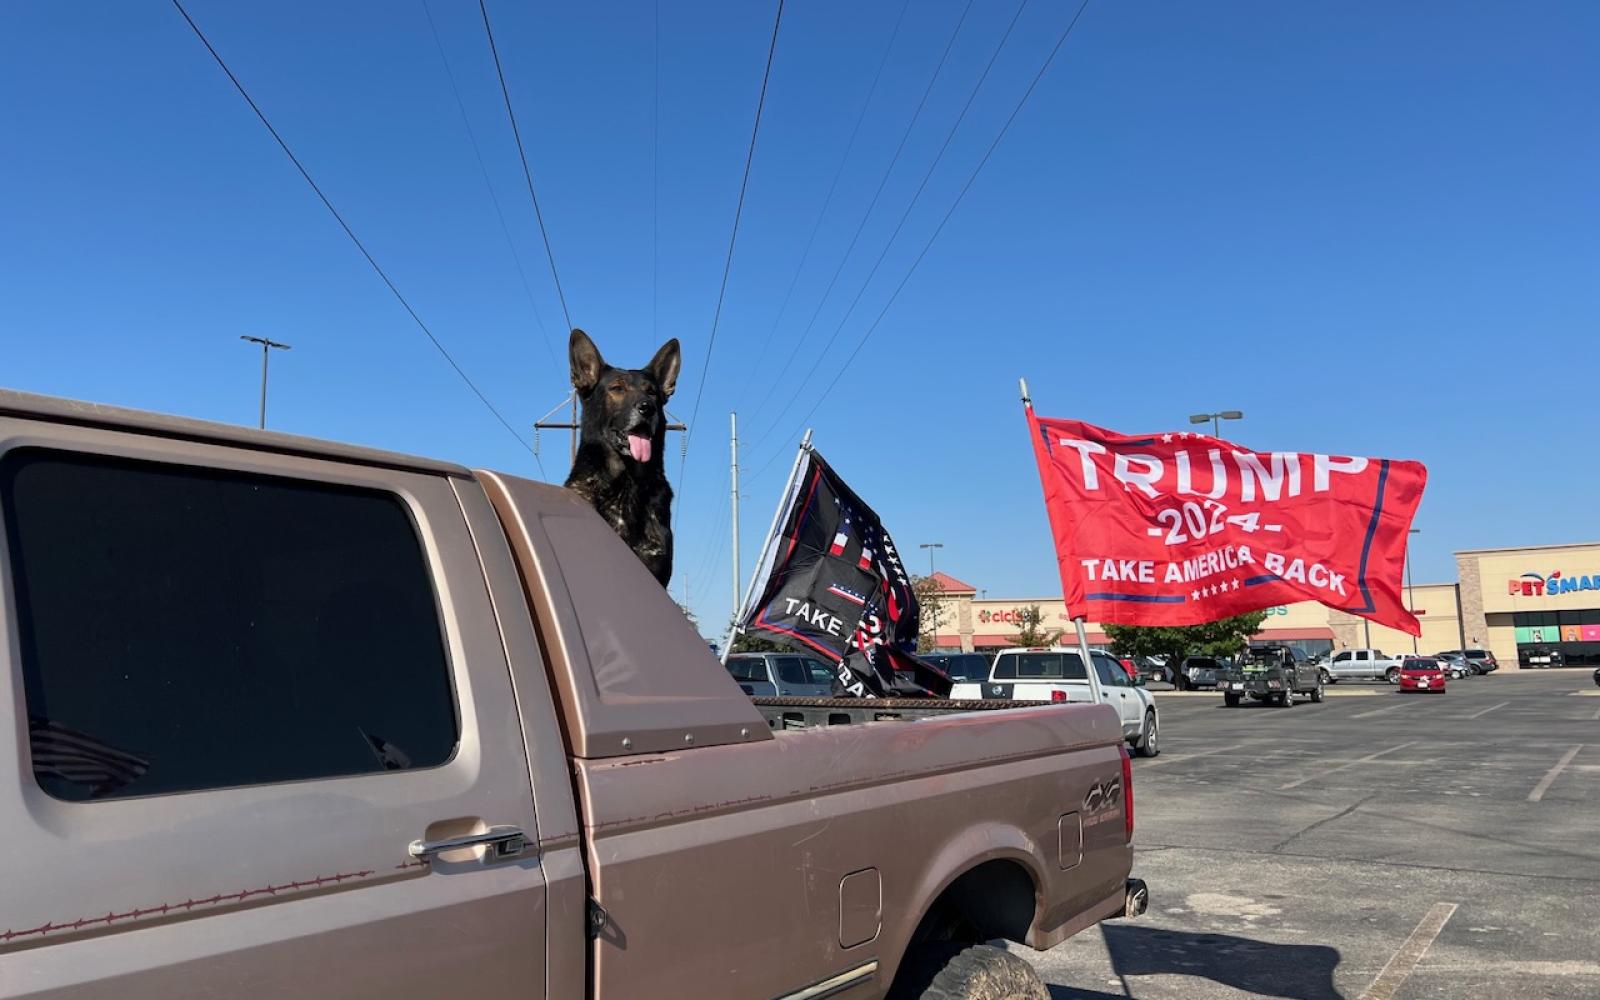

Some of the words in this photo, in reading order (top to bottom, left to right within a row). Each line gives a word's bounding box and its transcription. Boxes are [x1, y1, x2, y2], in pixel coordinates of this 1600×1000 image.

[1060, 438, 1368, 502] TRUMP
[1081, 559, 1155, 584] TAKE
[1164, 544, 1256, 583] AMERICA
[1264, 552, 1347, 596] BACK
[786, 597, 843, 637] TAKE
